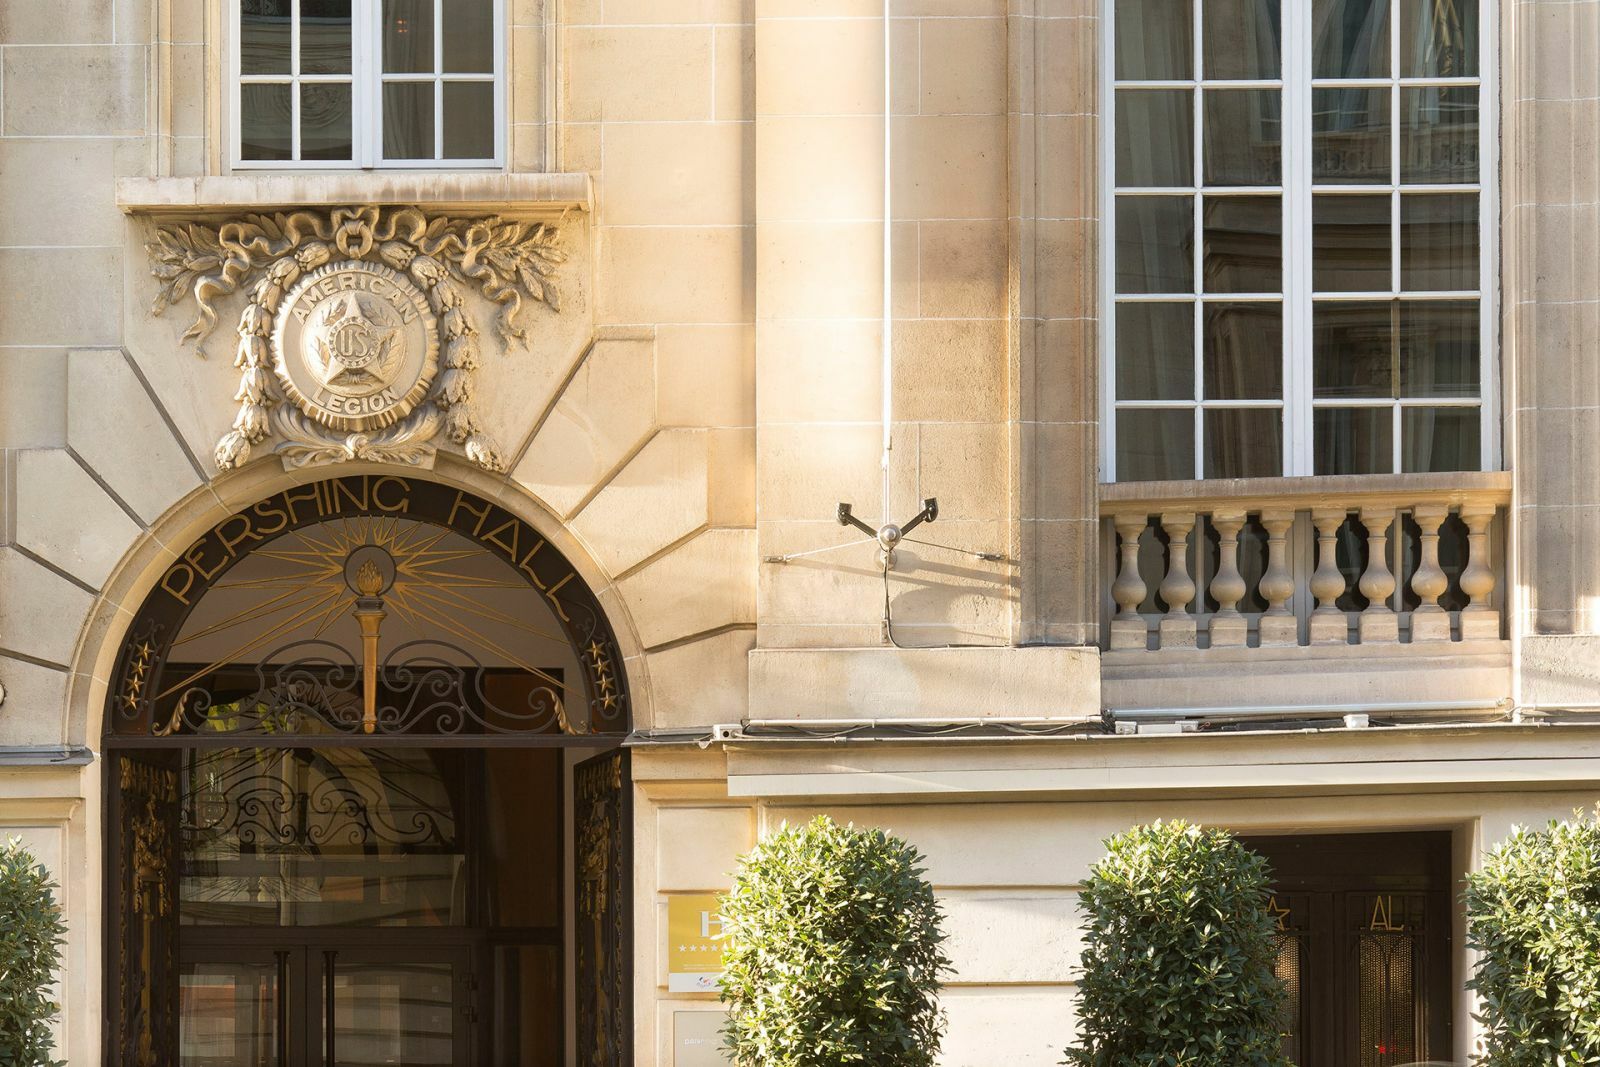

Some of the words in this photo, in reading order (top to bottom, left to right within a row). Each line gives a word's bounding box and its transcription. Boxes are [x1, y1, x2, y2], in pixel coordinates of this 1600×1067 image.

[292, 272, 419, 325] AMERICAN
[312, 386, 400, 415] LEGION
[161, 475, 411, 606] PERSHING
[448, 491, 576, 623] HALL
[1370, 895, 1404, 931] AL
